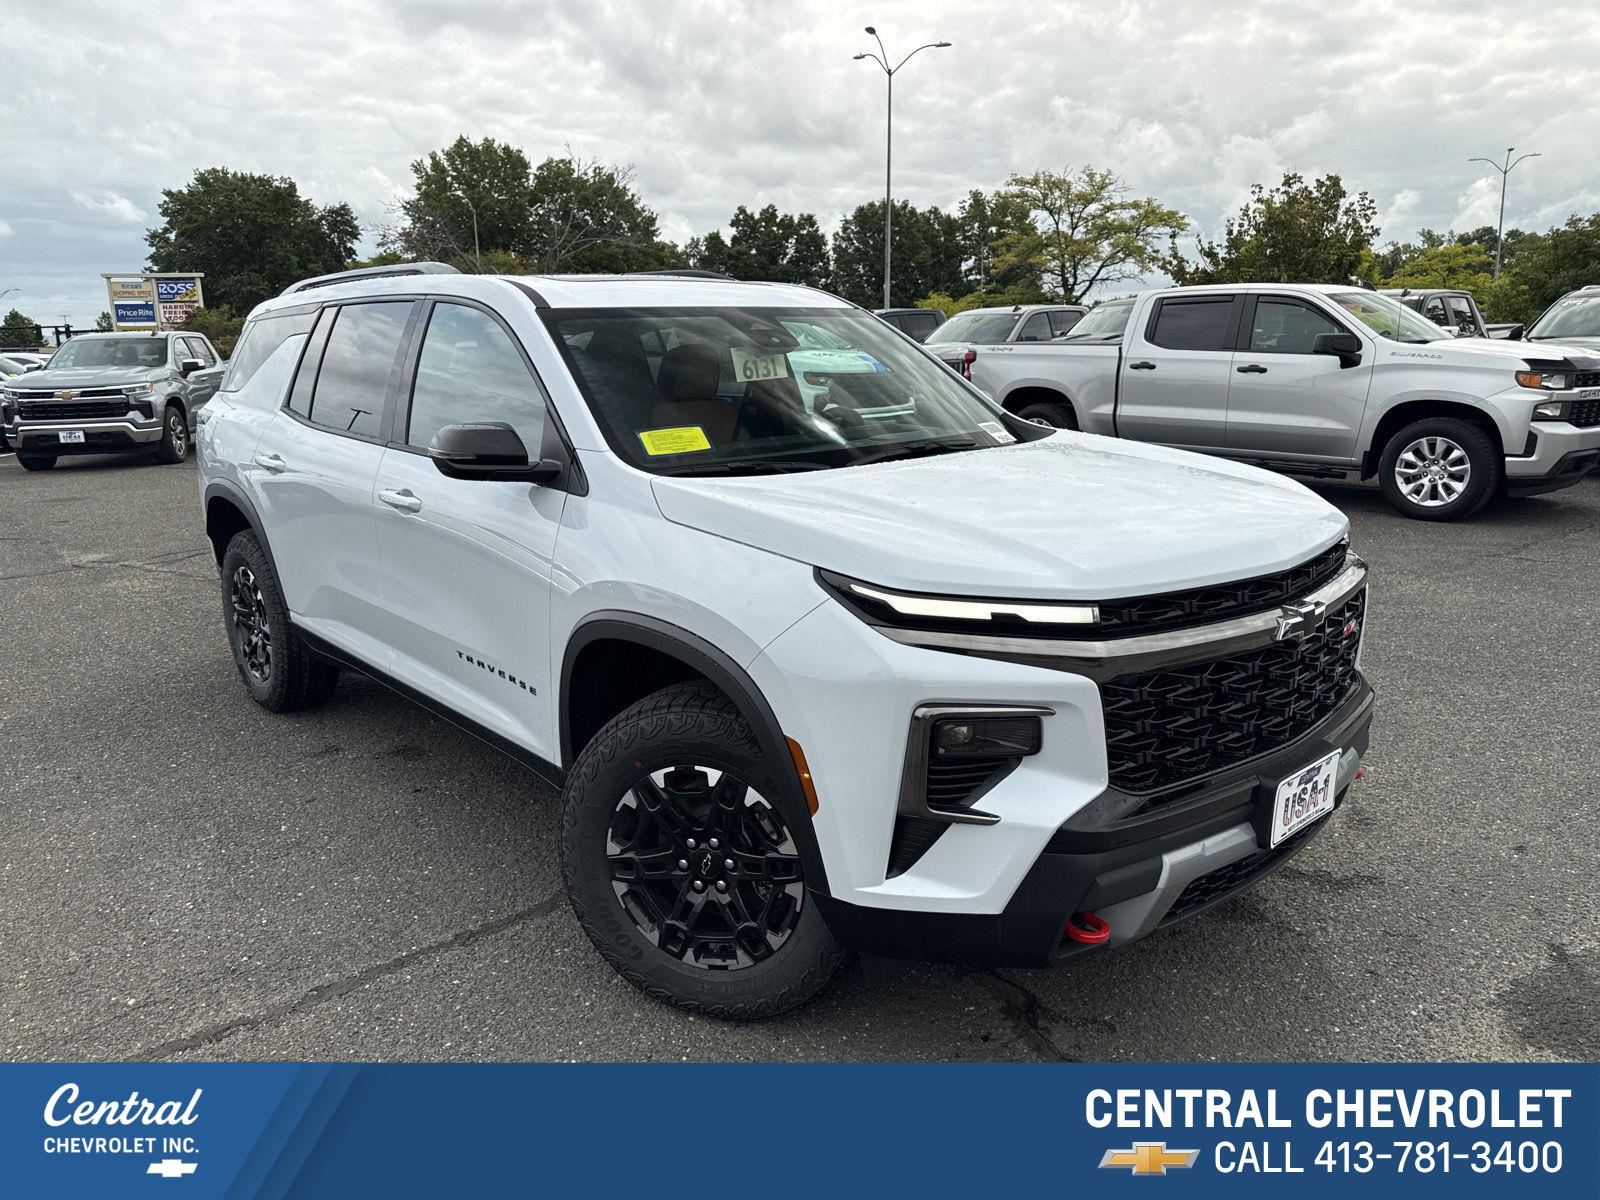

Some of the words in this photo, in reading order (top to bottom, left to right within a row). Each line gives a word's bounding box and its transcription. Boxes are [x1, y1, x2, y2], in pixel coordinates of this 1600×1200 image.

[158, 283, 194, 293] ROSS
[118, 309, 138, 317] Price
[138, 308, 154, 317] Rite
[742, 357, 778, 380] 6131
[456, 650, 537, 697] TRAVERSE
[1283, 773, 1330, 827] USA-1
